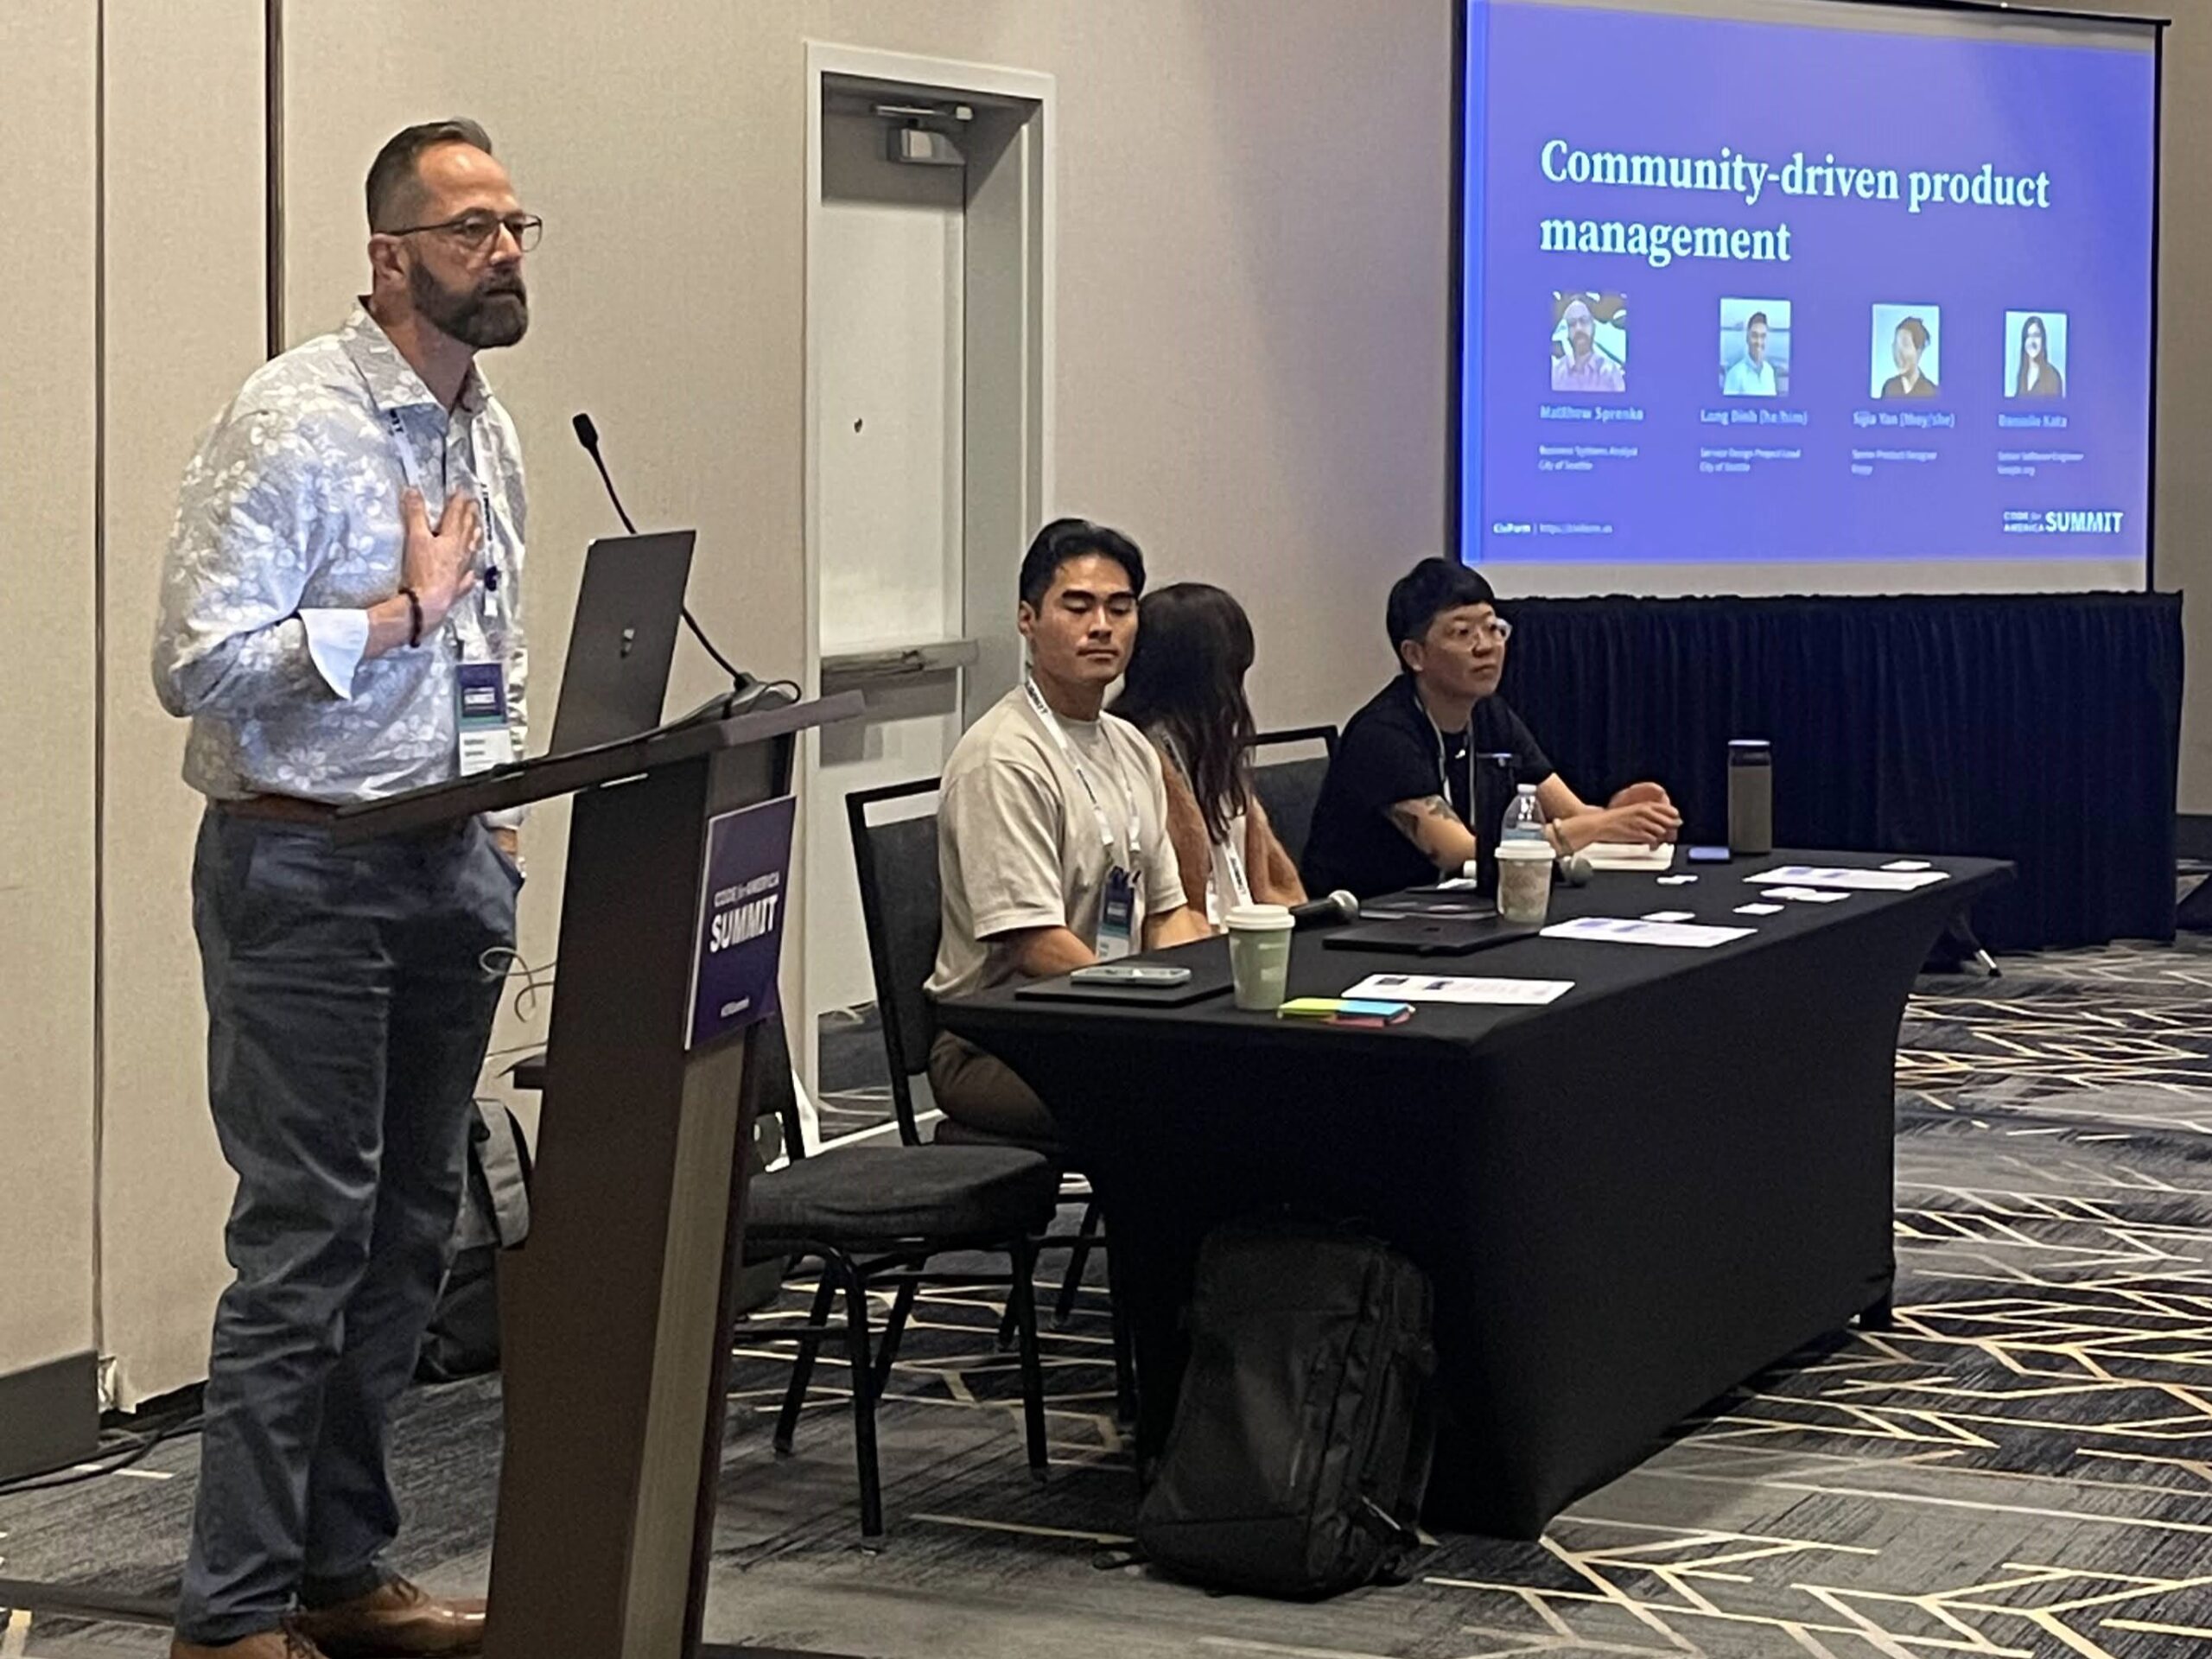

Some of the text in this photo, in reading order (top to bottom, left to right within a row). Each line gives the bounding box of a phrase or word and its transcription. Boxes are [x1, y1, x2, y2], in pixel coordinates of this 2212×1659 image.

[1541, 139, 2050, 213] Community-driven product
[1540, 218, 1791, 268] management
[2044, 511, 2124, 533] SUMMIT
[709, 893, 779, 954] SUMMIT
